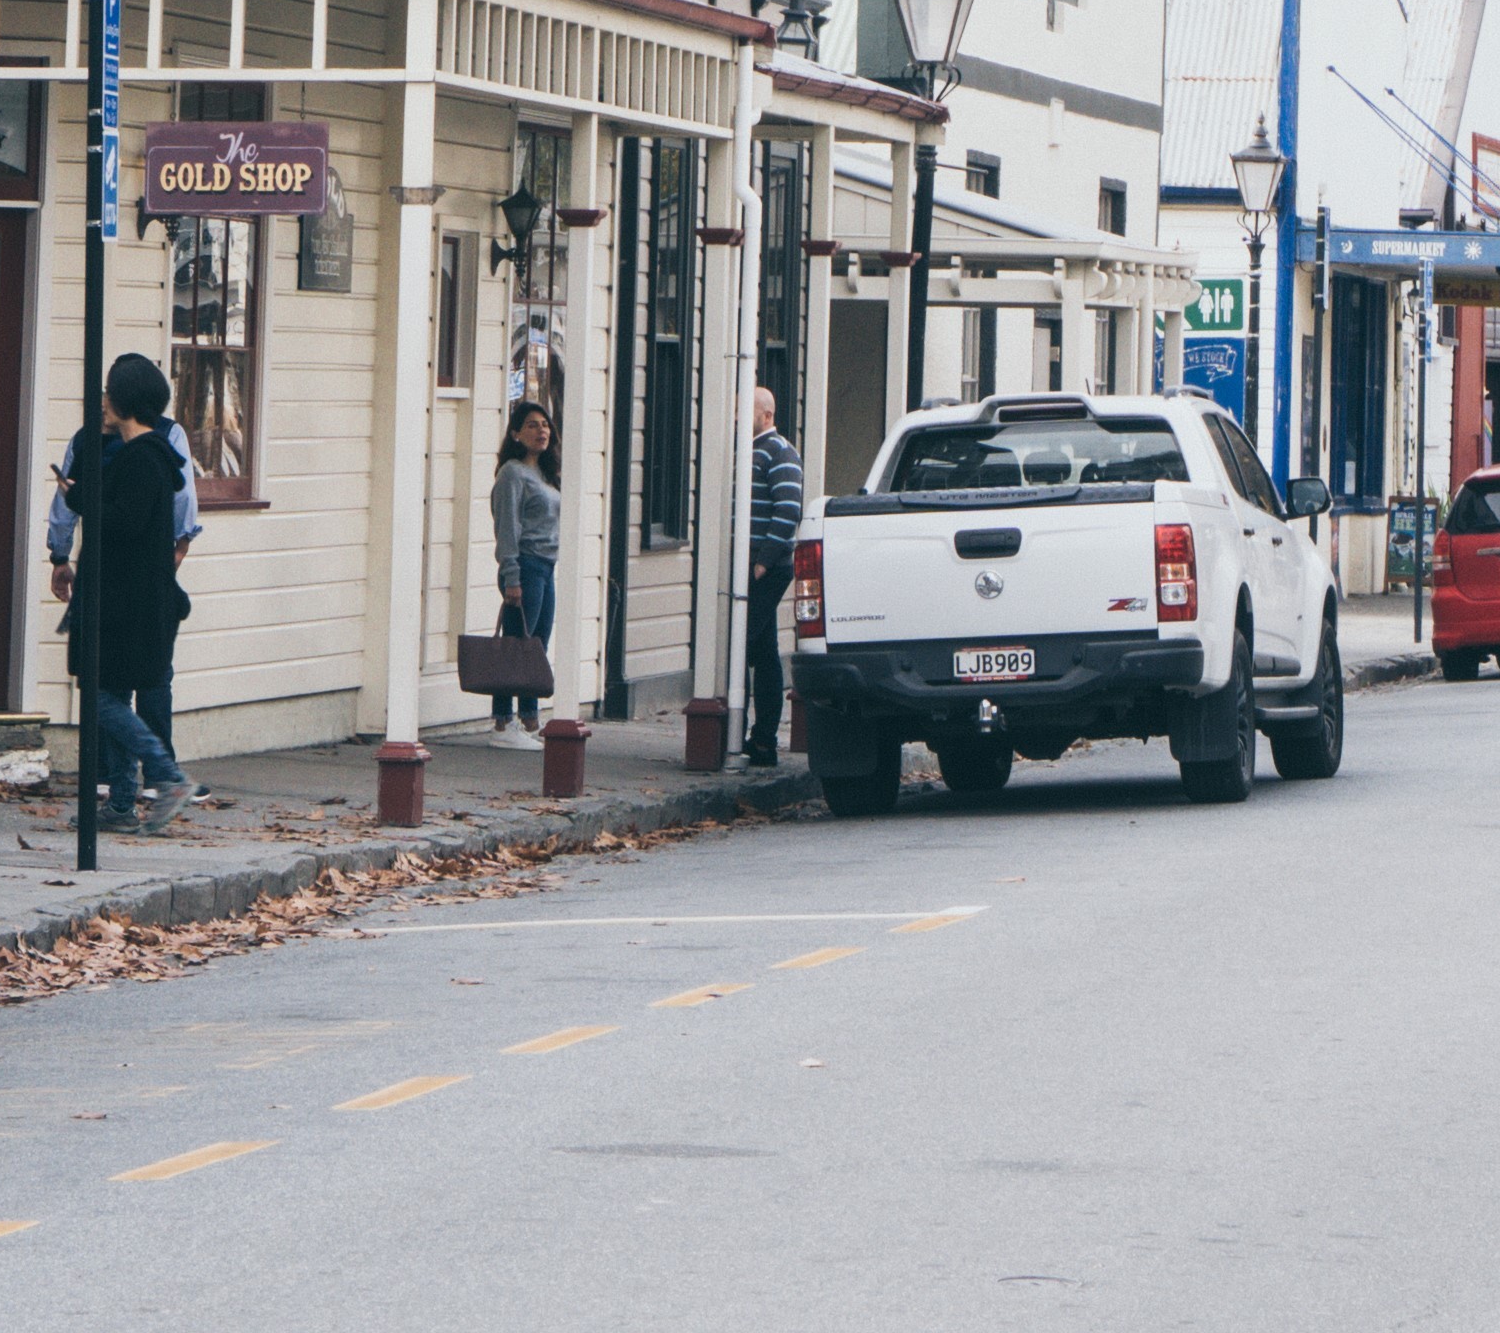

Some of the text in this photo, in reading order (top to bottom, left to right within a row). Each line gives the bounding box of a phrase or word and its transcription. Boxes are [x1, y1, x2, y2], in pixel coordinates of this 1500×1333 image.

[215, 131, 259, 165] The
[159, 162, 312, 192] GOLD SHOP
[1371, 240, 1447, 258] SUPERMARKET
[1435, 281, 1493, 301] Kodak
[1187, 351, 1225, 364] WE STOCK
[1394, 519, 1433, 531] HEE
[830, 614, 886, 624] COLORADO
[955, 652, 1033, 675] LJB909
